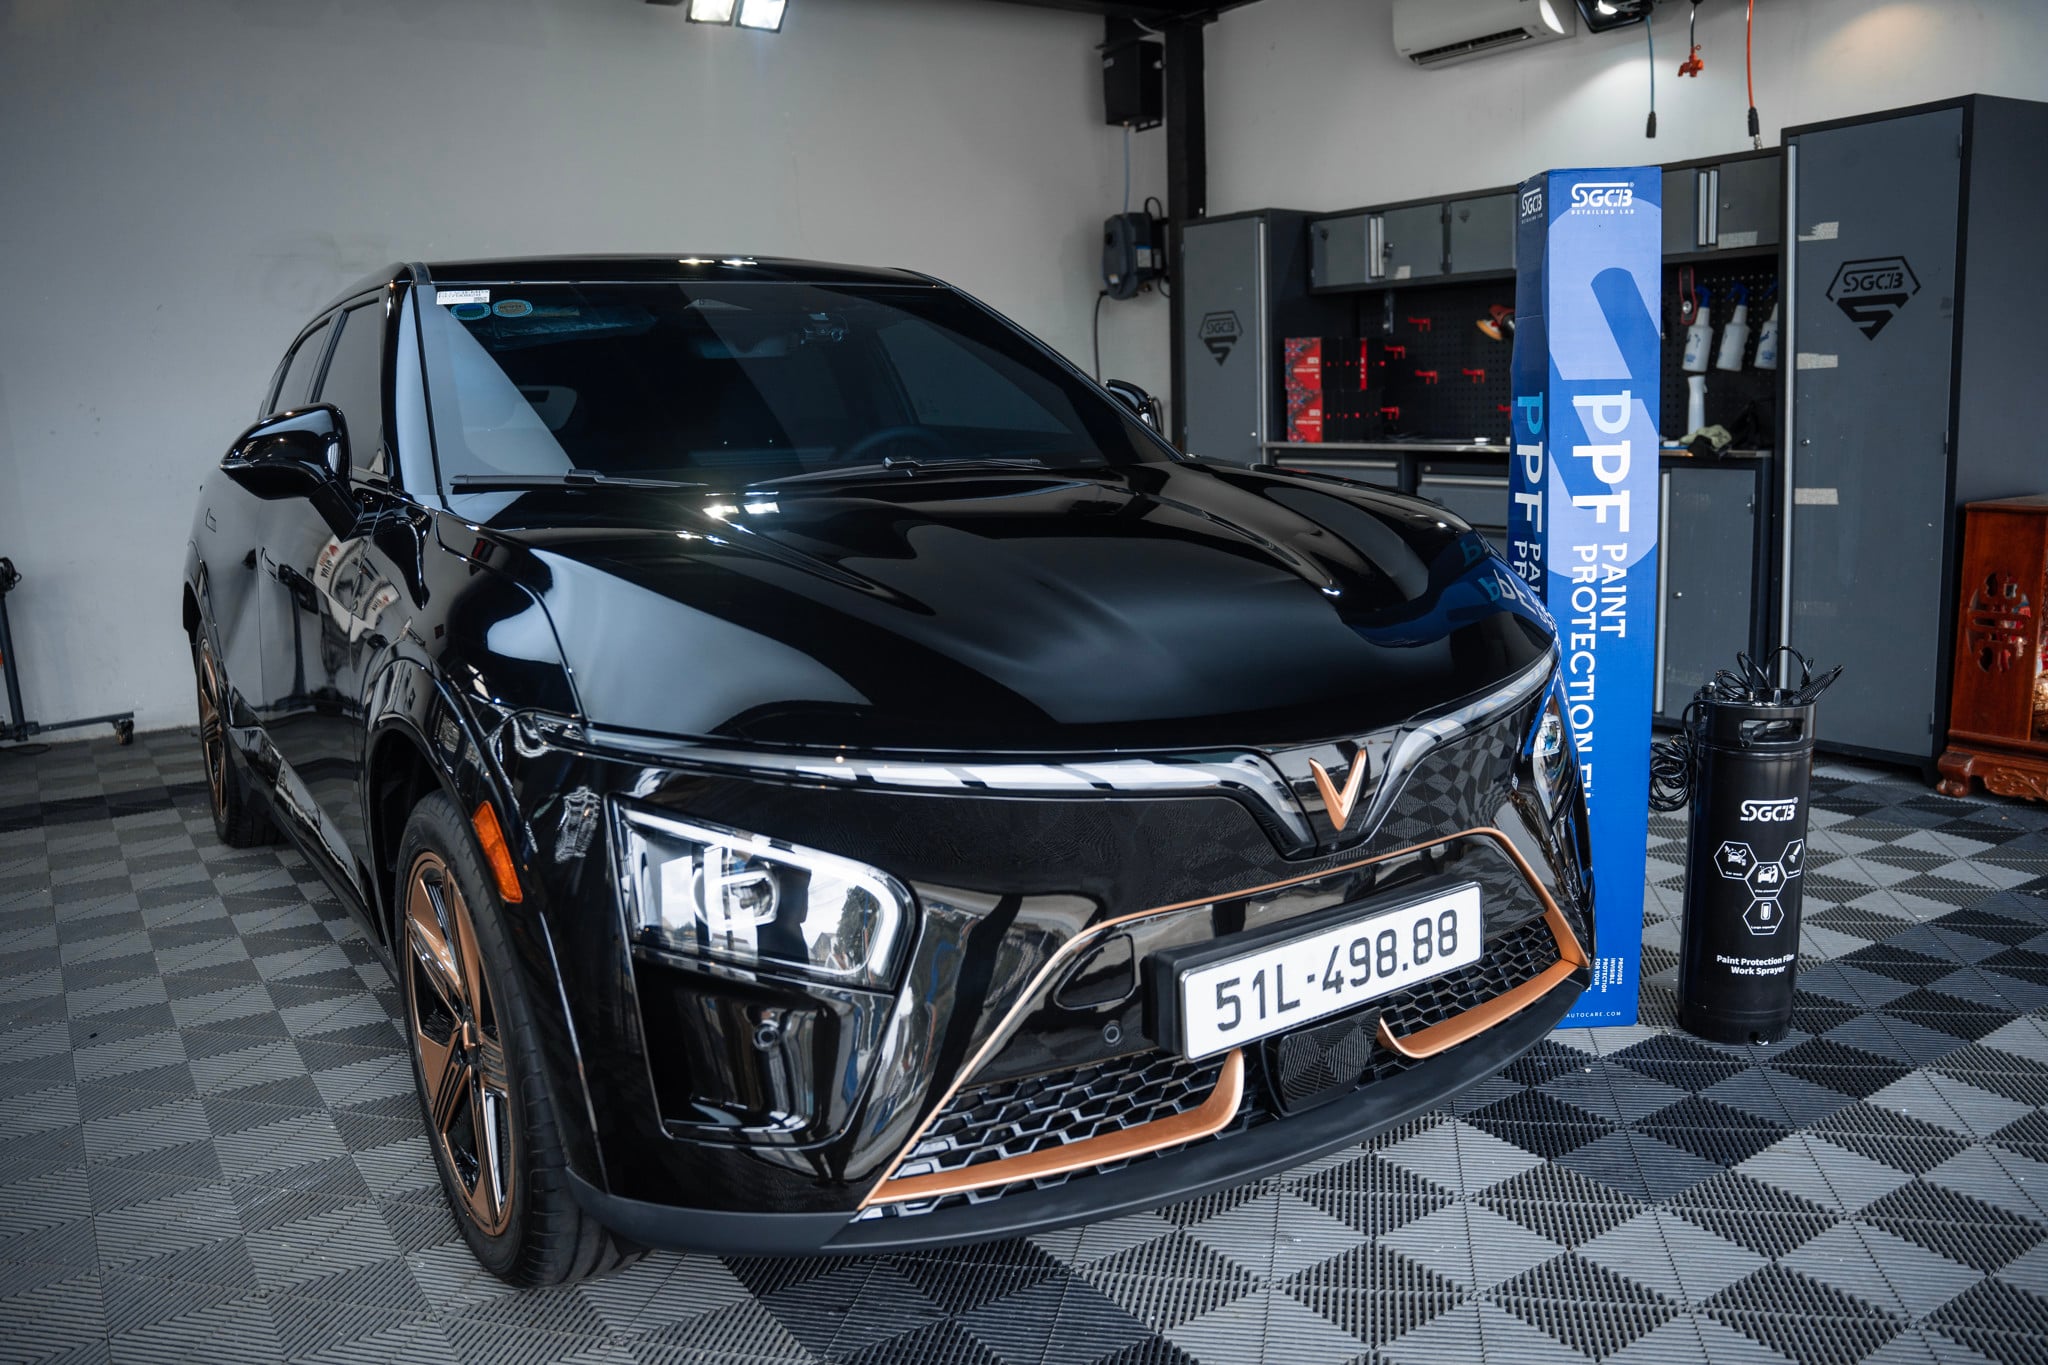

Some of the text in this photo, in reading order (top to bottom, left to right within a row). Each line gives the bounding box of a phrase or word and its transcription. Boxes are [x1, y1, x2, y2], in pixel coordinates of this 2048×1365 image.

[1522, 187, 1543, 217] SGCB
[1571, 182, 1633, 208] SGCB
[1843, 266, 1904, 293] SGCB
[1514, 391, 1543, 533] PPF
[1572, 390, 1631, 532] PPF
[1600, 542, 1628, 638] PAINT
[1570, 543, 1598, 752] PROTECTION
[1740, 799, 1796, 822] SGCB
[1215, 908, 1458, 1032] 51L-498.88
[1716, 954, 1740, 965] Paint
[1741, 957, 1782, 966] Protection
[1731, 966, 1786, 976] Work Sprayer
